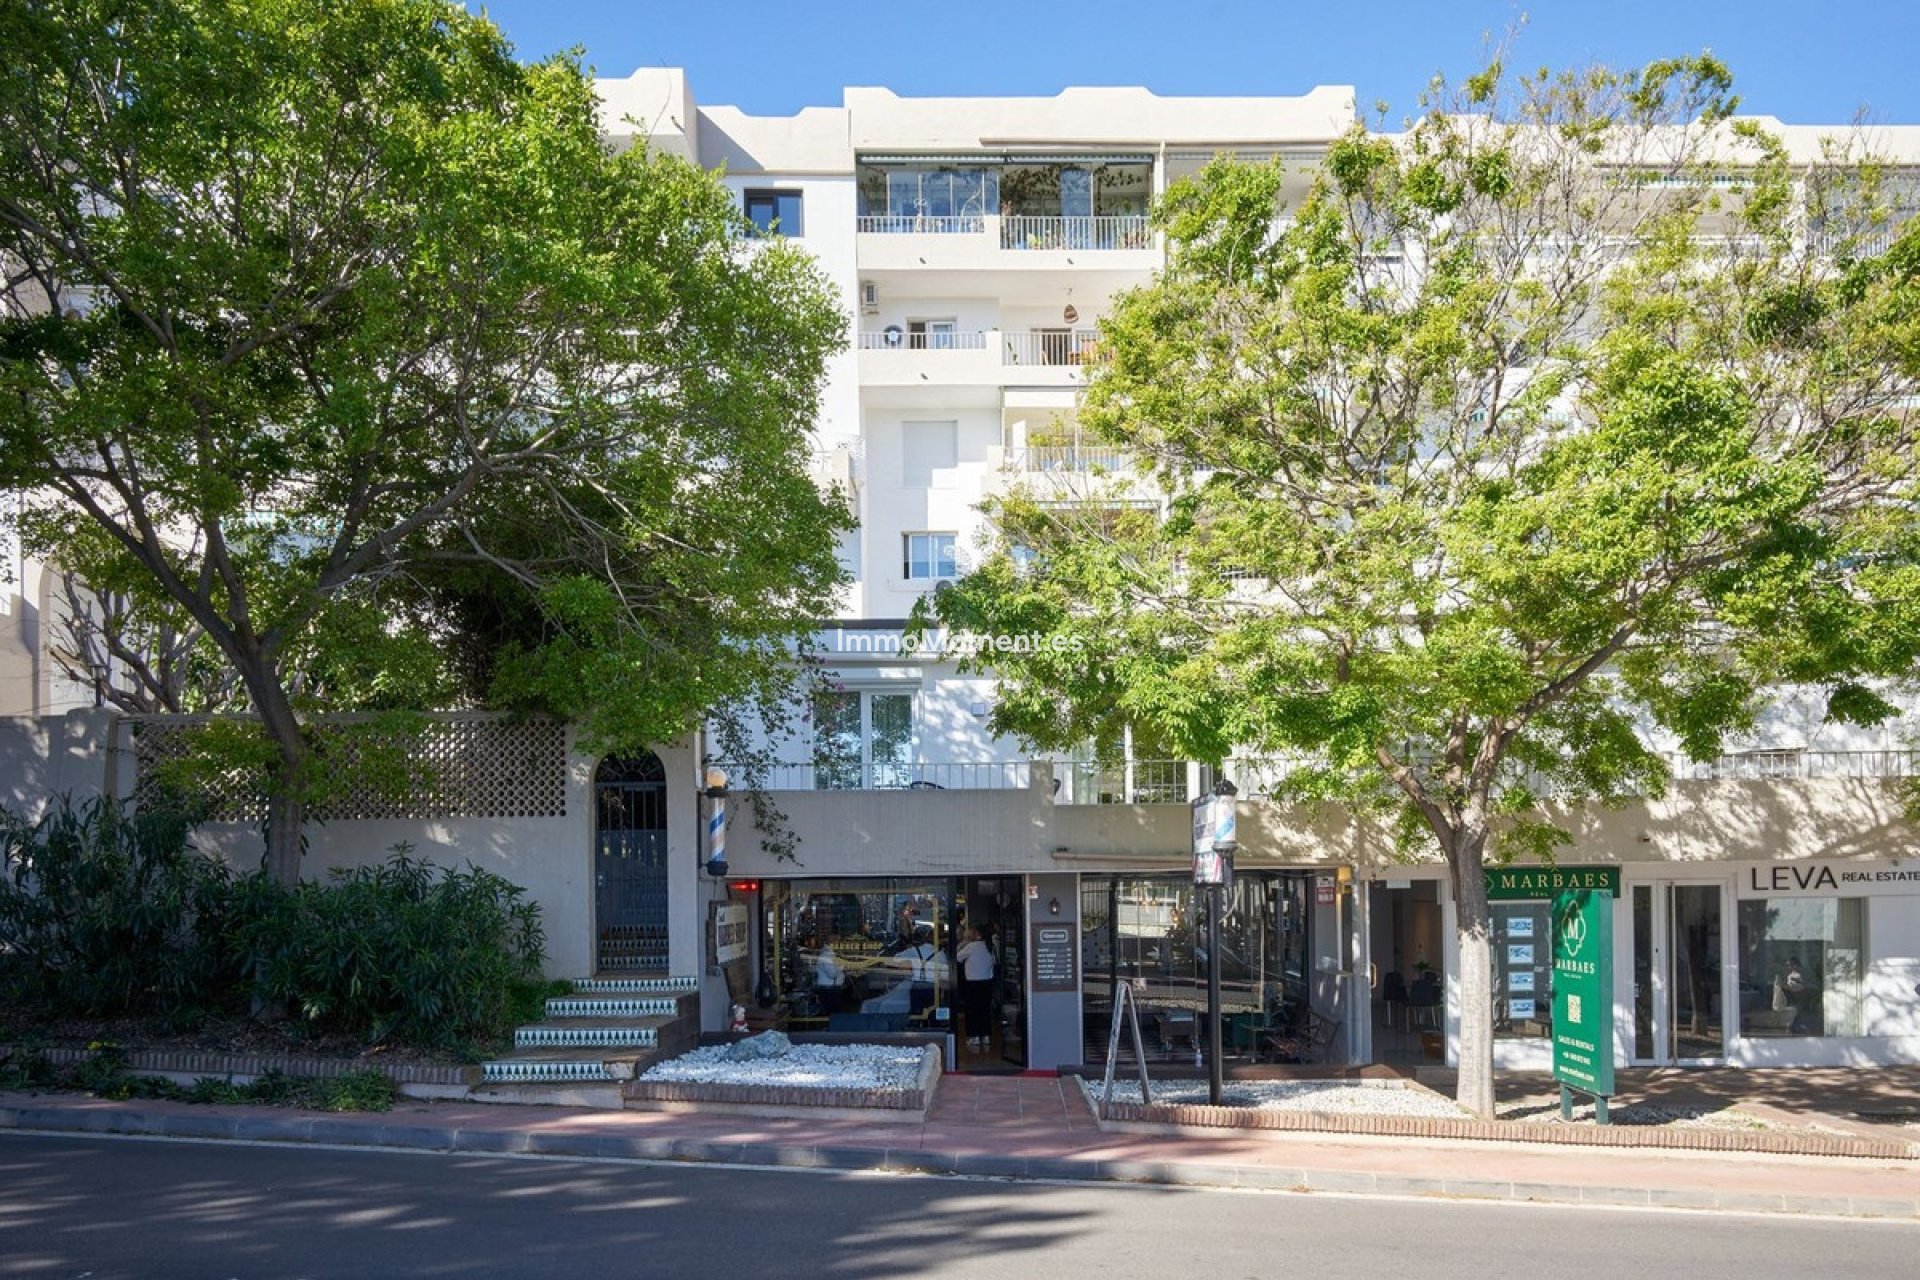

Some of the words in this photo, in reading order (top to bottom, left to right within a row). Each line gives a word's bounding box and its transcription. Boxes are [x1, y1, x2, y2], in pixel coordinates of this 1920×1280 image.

[1501, 873, 1609, 889] MARBAES
[1751, 866, 1838, 891] LEVA
[1842, 872, 1873, 882] REAL
[1876, 871, 1920, 881] ESTATE
[1555, 958, 1596, 975] MARBAES
